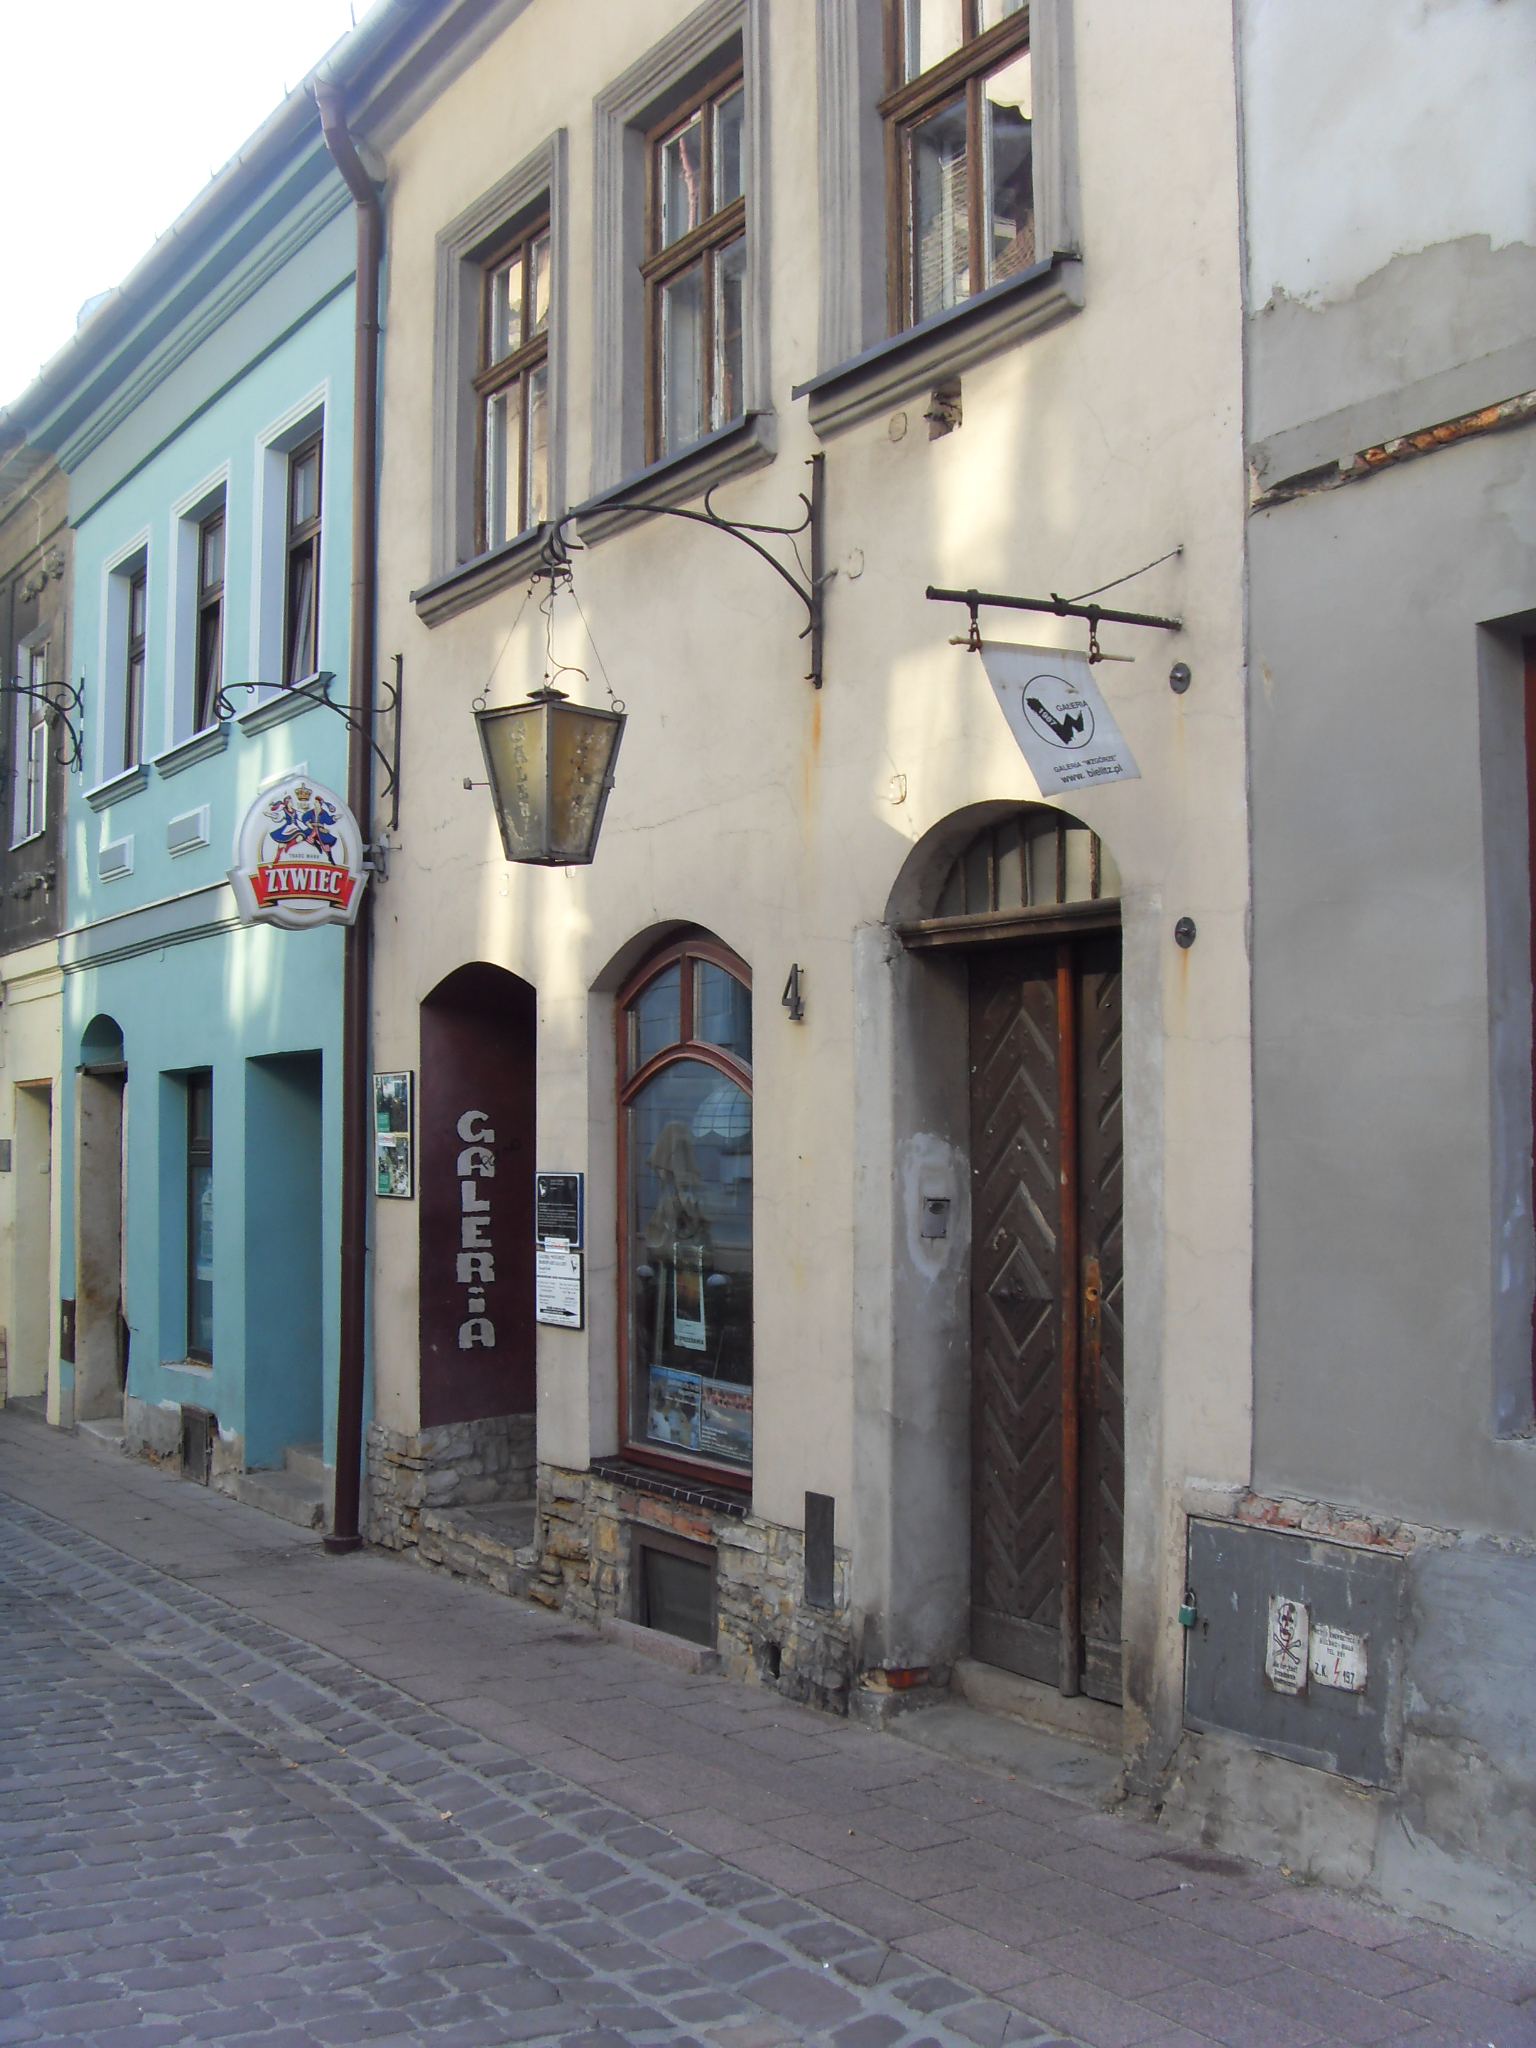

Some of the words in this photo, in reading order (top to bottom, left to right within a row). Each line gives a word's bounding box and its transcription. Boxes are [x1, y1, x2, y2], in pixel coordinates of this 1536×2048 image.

[1056, 700, 1088, 712] GALERIA
[1053, 761, 1082, 773] GALERIA
[781, 963, 801, 1021] 4
